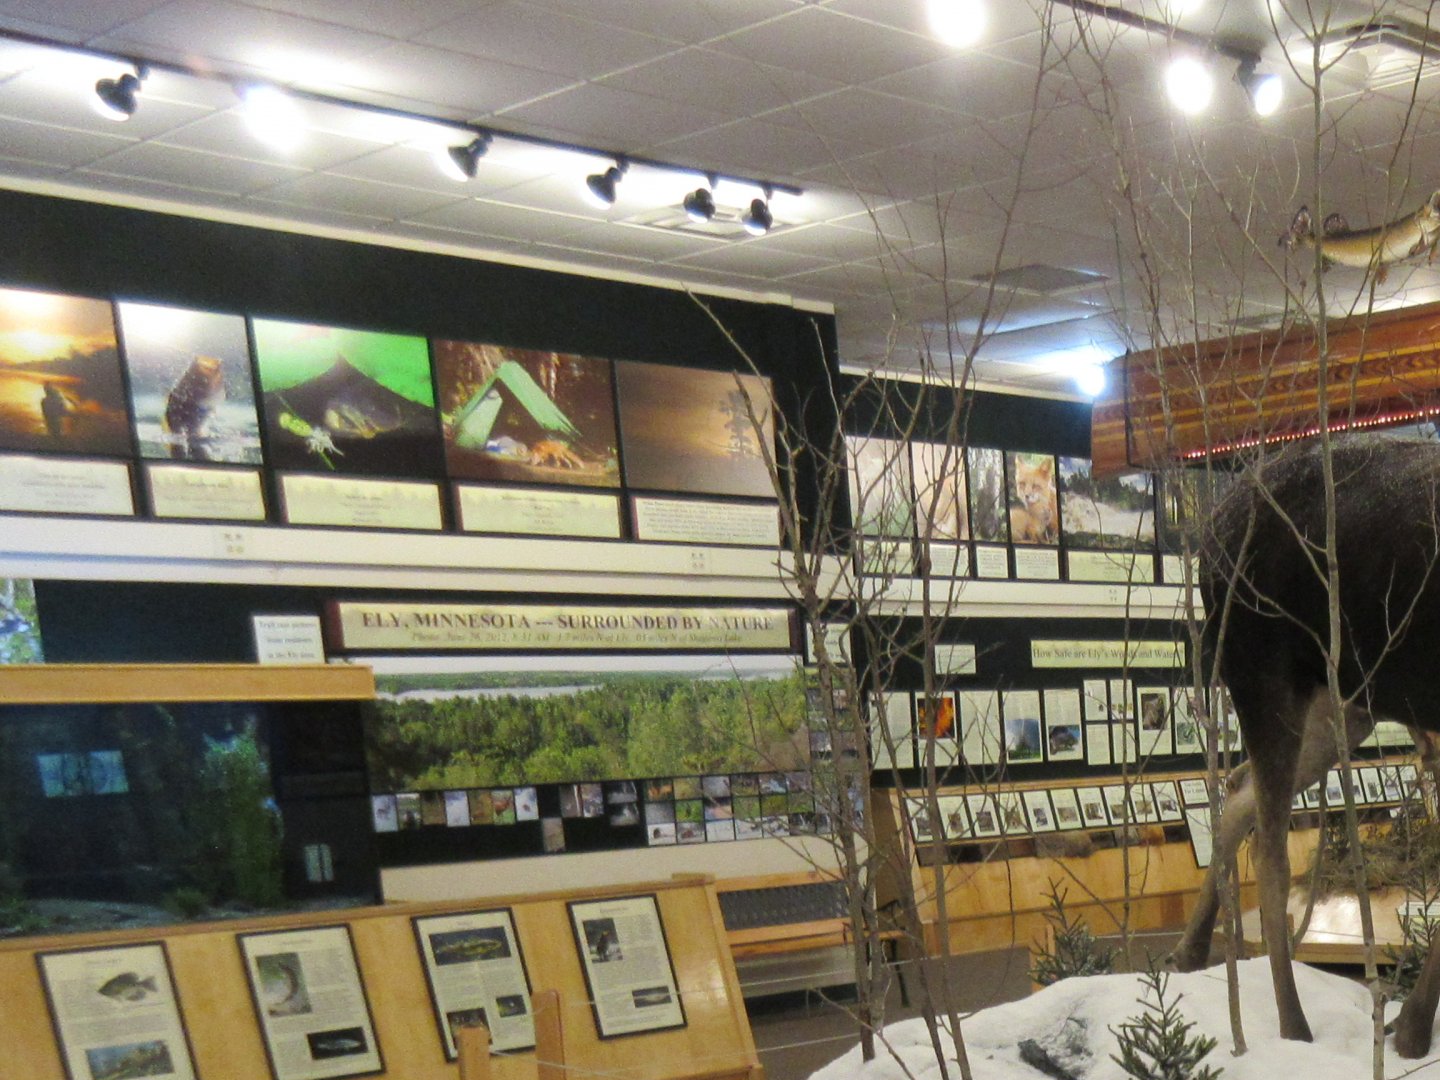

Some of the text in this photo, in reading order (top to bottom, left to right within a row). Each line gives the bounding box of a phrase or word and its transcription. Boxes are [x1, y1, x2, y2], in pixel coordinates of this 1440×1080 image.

[362, 612, 409, 629] ELY,
[413, 612, 531, 629] MINNESOTA
[557, 614, 678, 630] SURROUNDED
[683, 616, 704, 630] BY
[708, 616, 774, 630] NATURE
[1033, 648, 1052, 659] How
[1054, 648, 1072, 659] Safe
[1074, 650, 1086, 659] are
